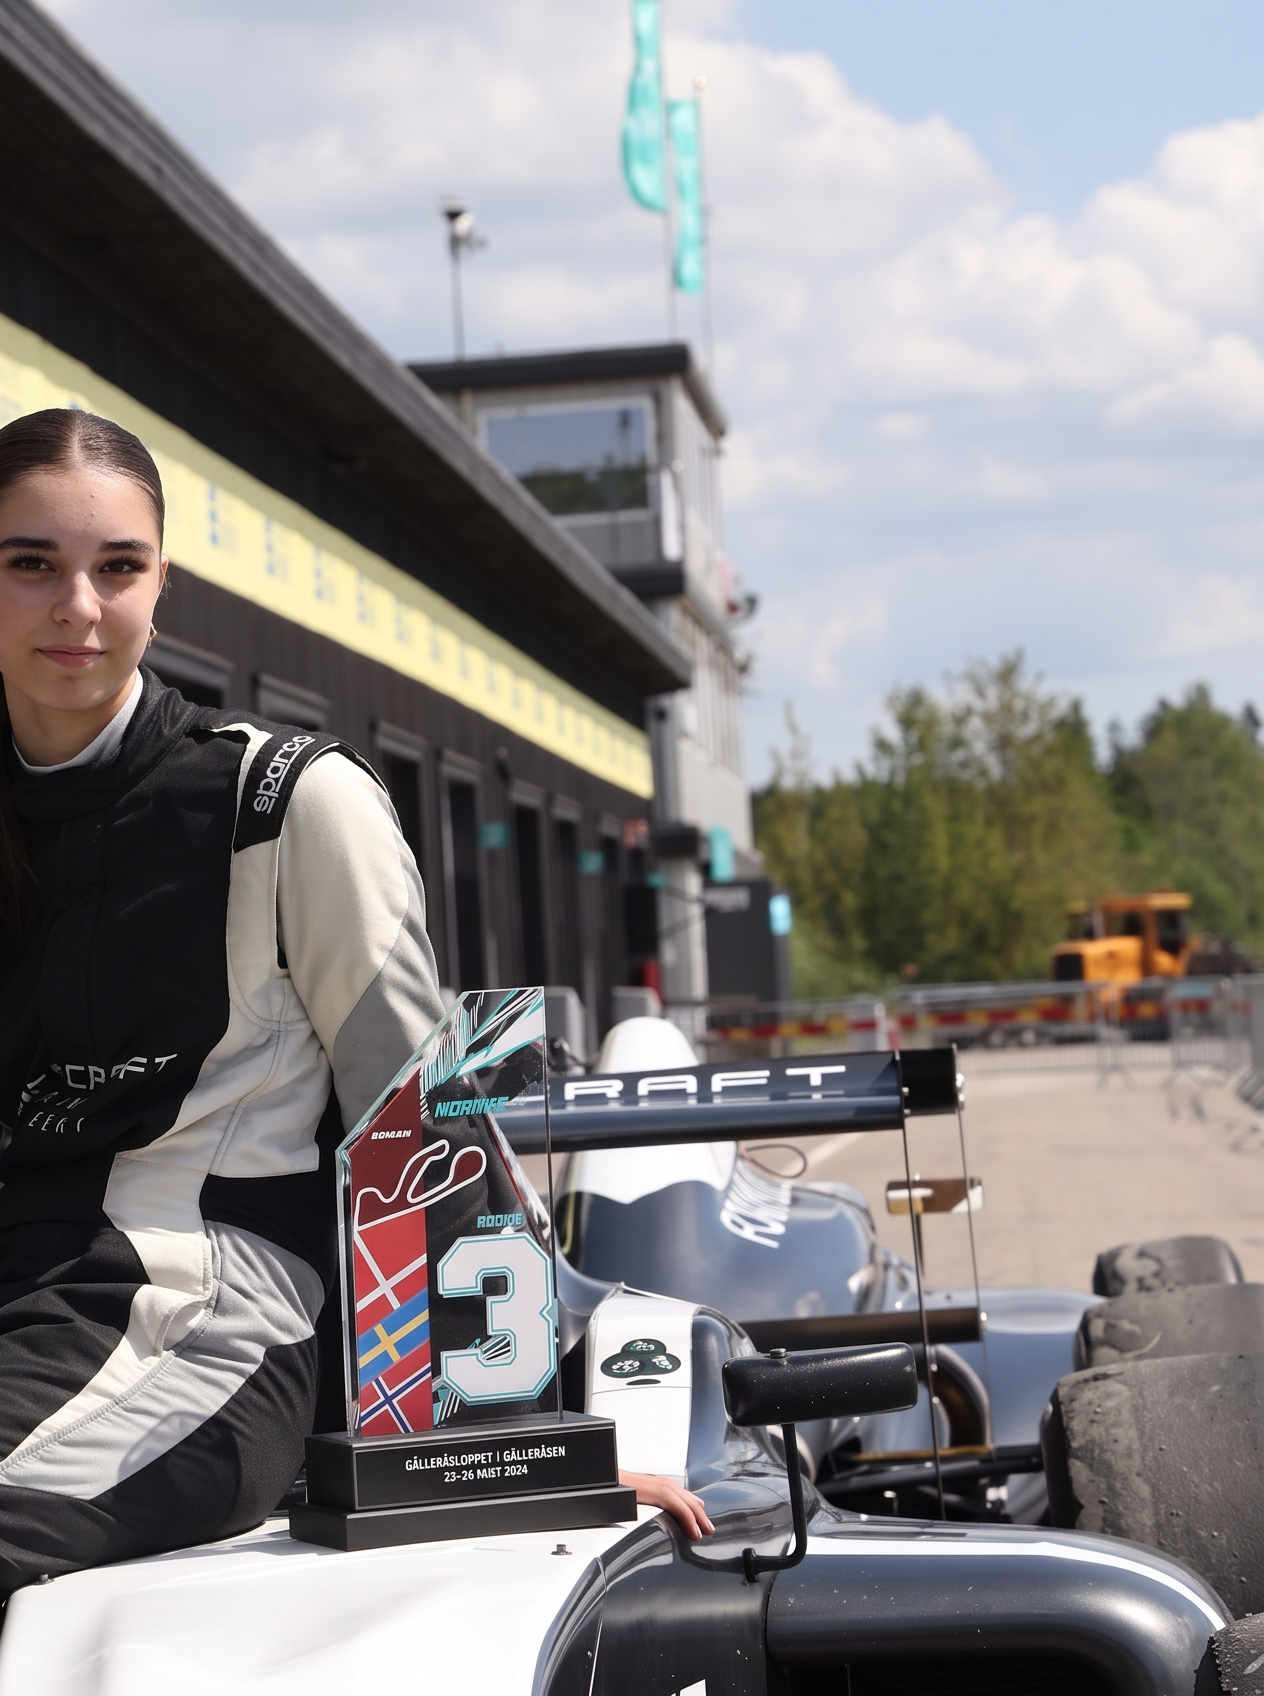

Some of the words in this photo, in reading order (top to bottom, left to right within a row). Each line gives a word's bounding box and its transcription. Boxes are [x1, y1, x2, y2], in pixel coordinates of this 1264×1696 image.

[253, 735, 315, 814] sparco
[512, 1064, 846, 1102] RAFT
[437, 1232, 558, 1406] 3
[444, 1470, 475, 1483] 23-26
[504, 1464, 529, 1477] 2024
